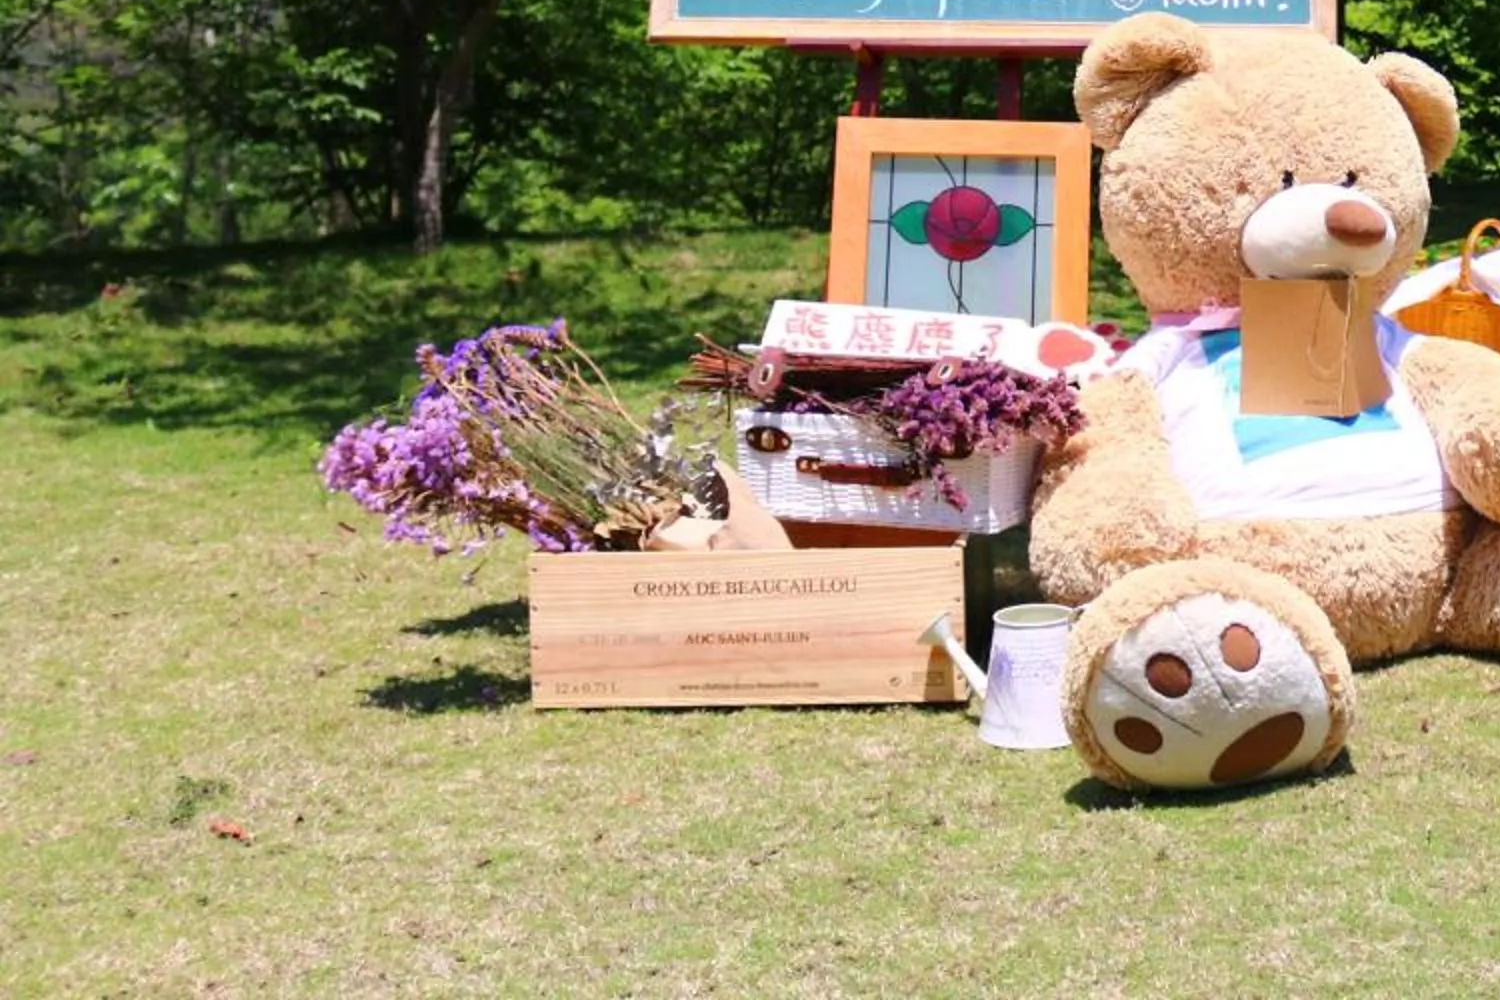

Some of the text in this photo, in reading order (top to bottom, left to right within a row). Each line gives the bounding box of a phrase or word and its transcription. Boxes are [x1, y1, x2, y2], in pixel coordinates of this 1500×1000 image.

[633, 576, 857, 597] CROIX DE BEAUCAILLOU
